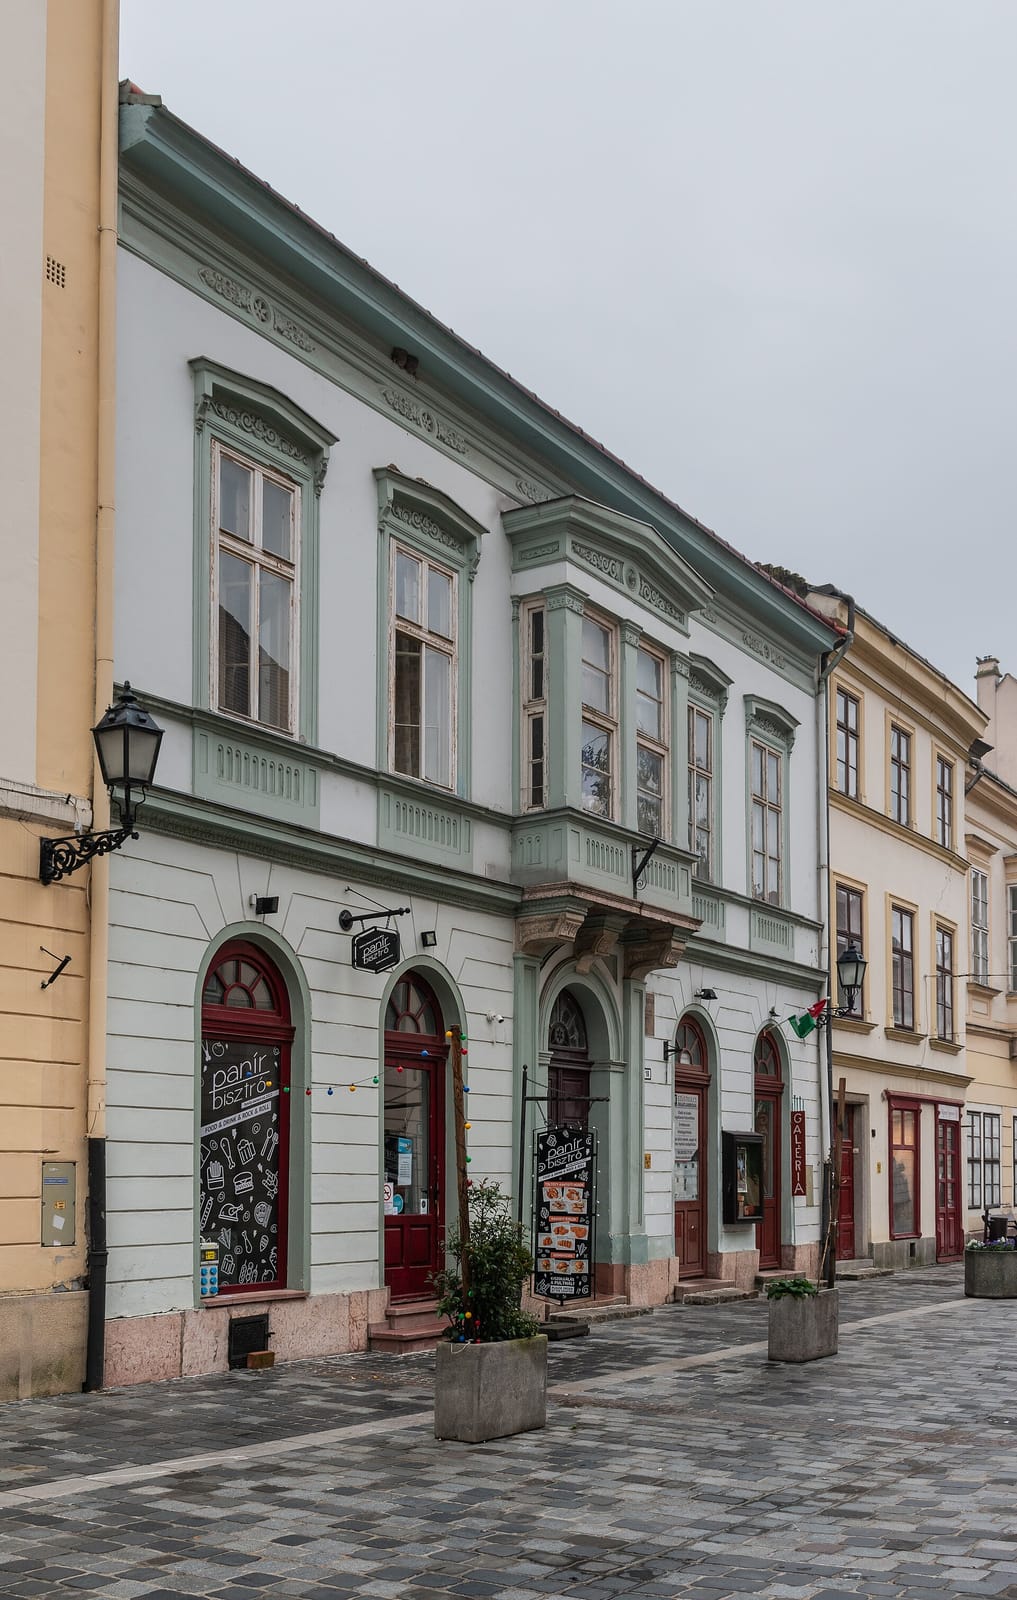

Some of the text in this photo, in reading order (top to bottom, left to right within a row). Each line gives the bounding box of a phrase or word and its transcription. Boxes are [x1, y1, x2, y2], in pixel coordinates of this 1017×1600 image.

[213, 1052, 267, 1091] panír
[212, 1076, 266, 1110] bisztró
[547, 1138, 583, 1159] panír
[547, 1150, 583, 1169] bisztró
[793, 1113, 804, 1194] GALÉRIA
